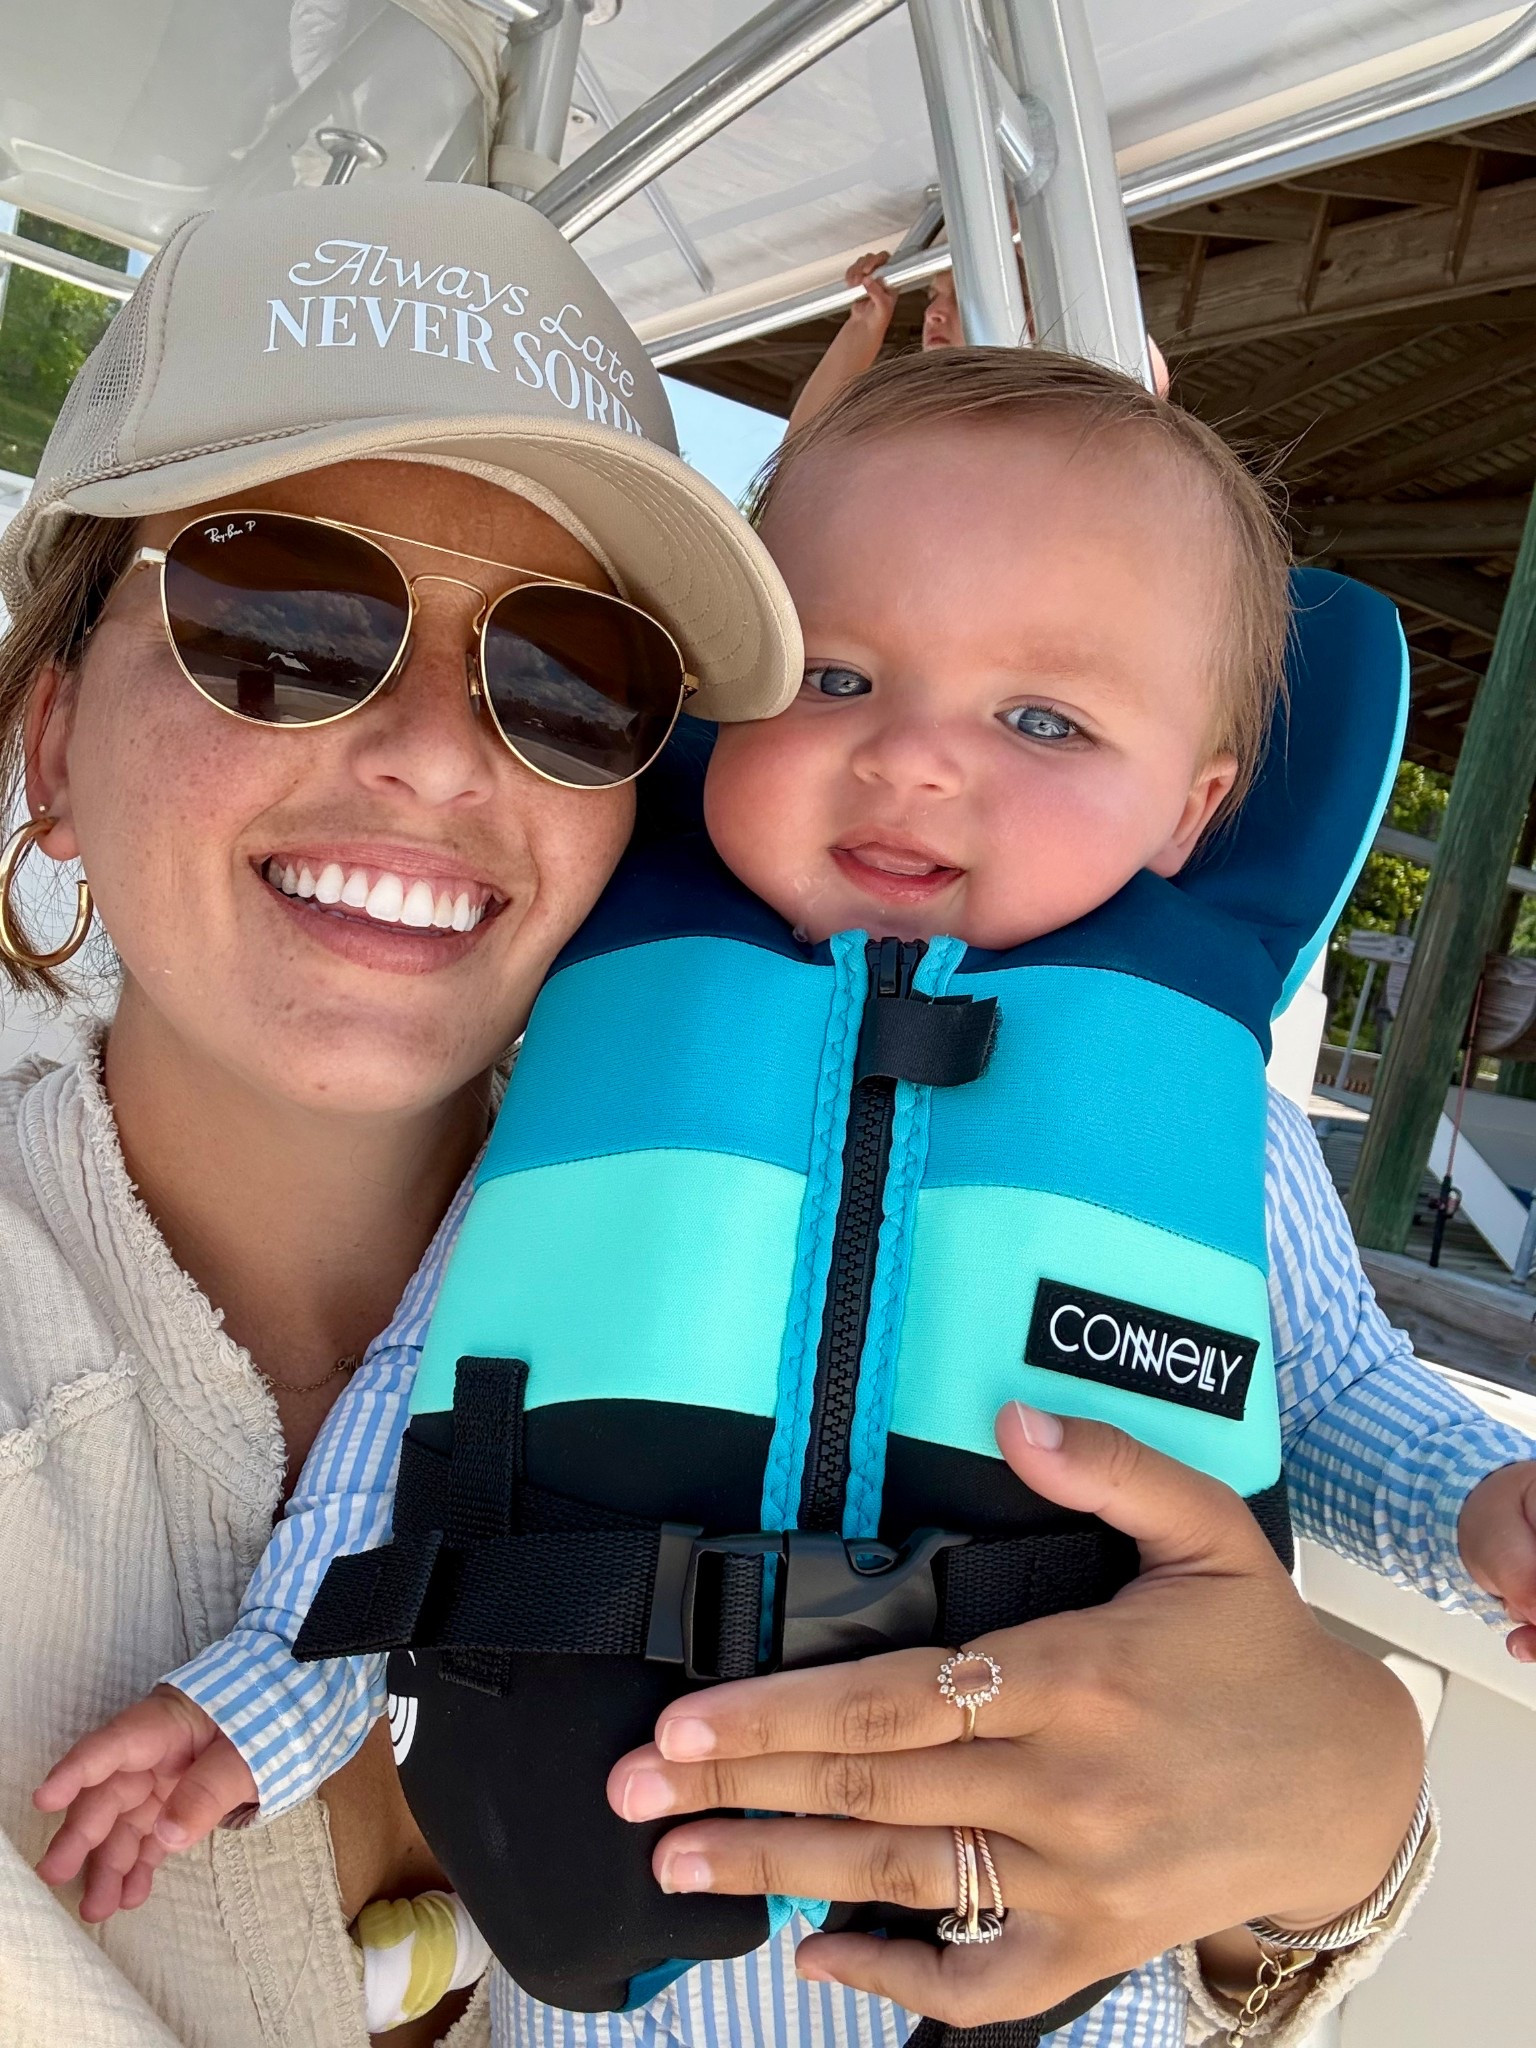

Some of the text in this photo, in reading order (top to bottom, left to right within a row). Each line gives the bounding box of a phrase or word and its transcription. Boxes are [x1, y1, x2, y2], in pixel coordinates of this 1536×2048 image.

[262, 295, 649, 440] NEVER SORR
[288, 239, 635, 398] Always Late
[245, 520, 256, 531] P
